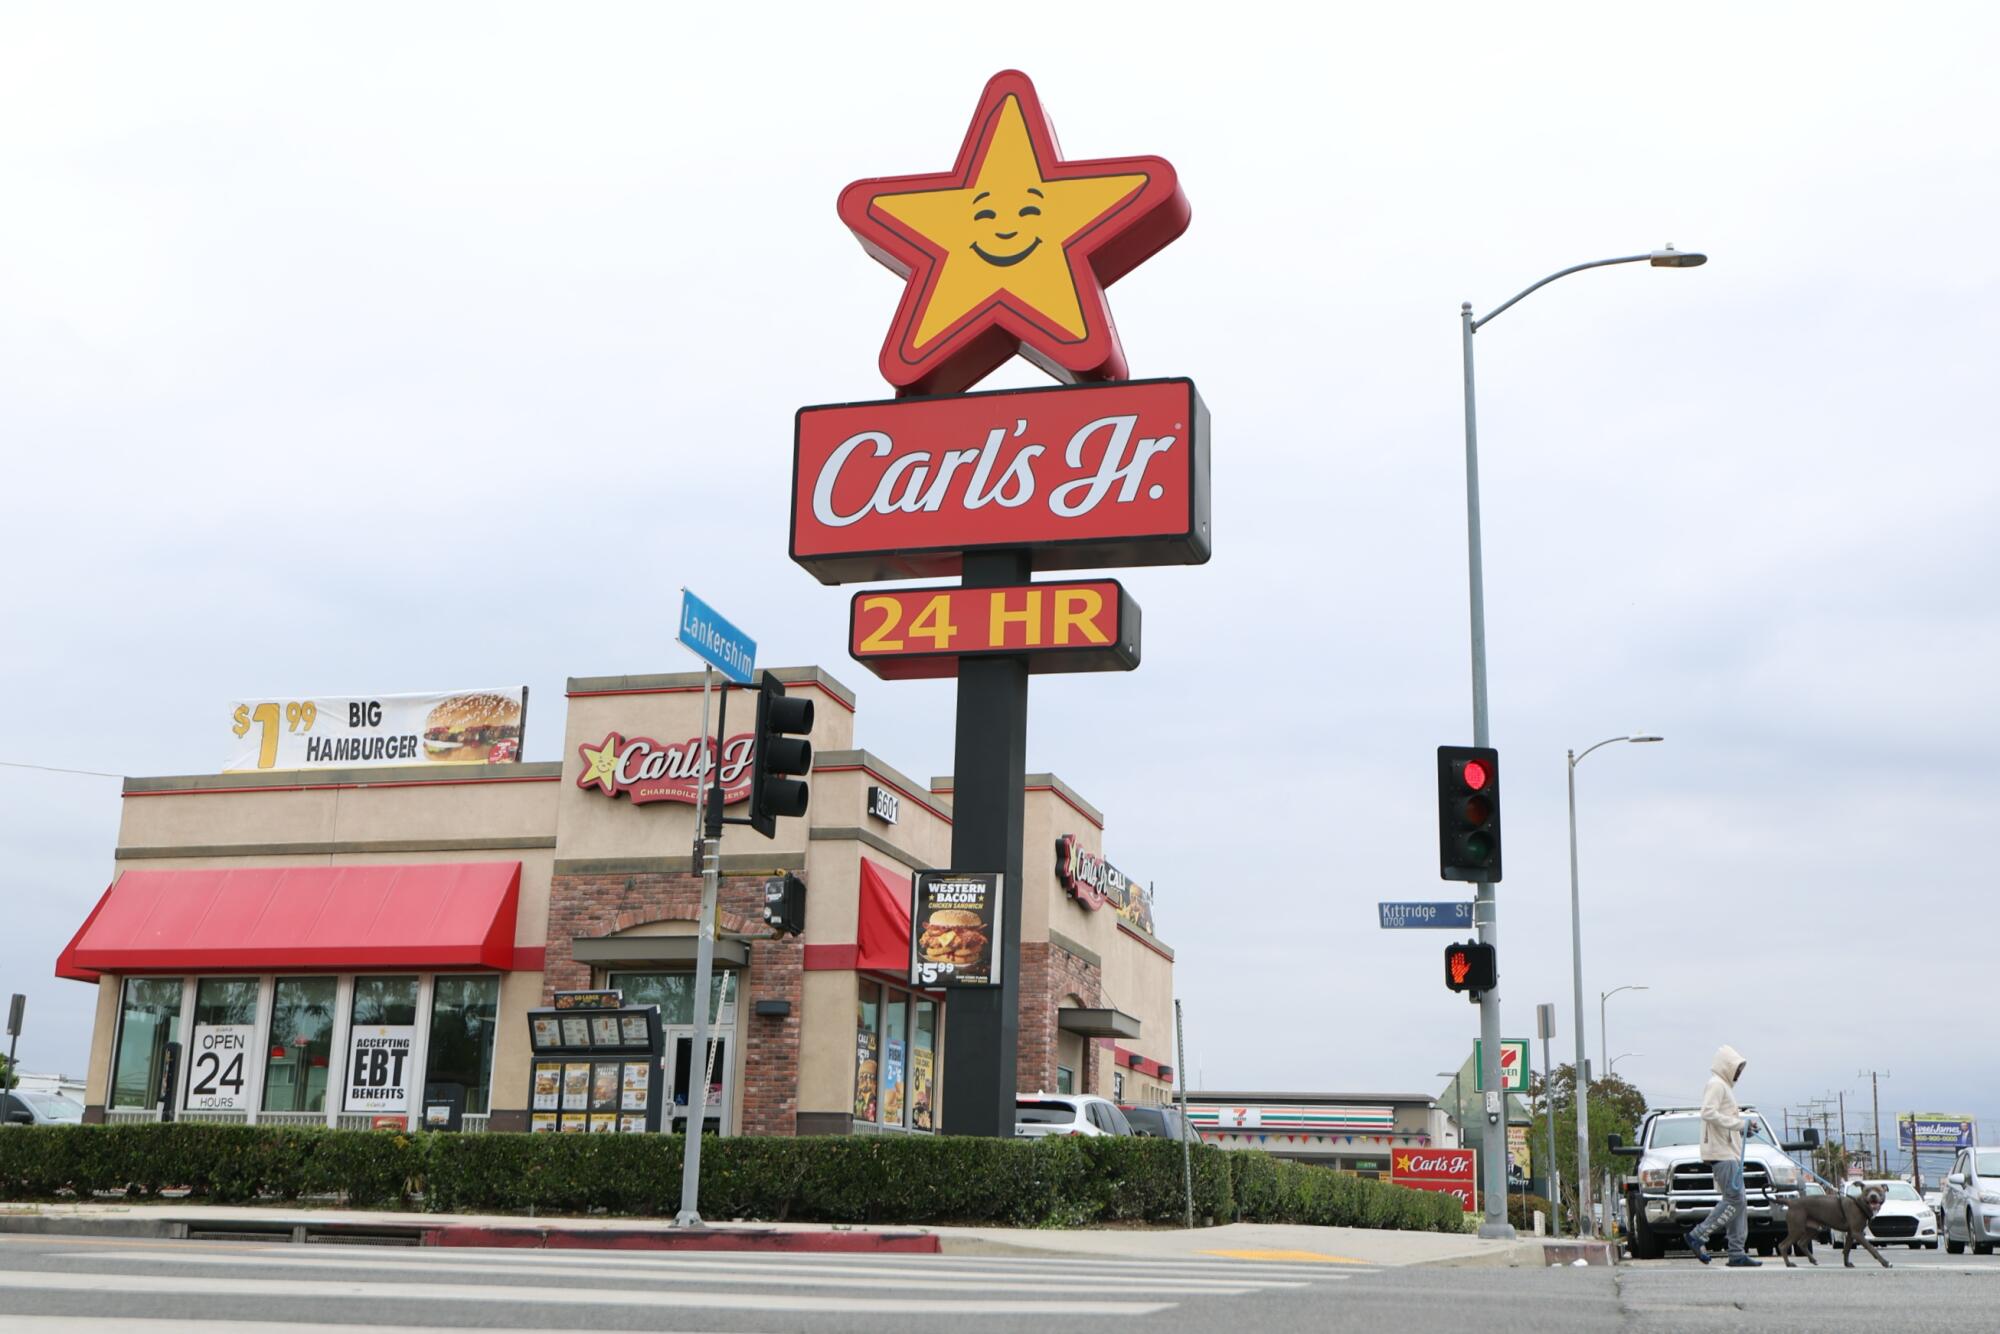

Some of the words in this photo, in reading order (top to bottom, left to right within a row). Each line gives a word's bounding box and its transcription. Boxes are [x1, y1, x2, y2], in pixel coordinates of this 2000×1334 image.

[811, 418, 1047, 527] Carl's
[1048, 414, 1177, 518] Jr.
[860, 594, 958, 651] 24
[988, 588, 1110, 647] HR
[683, 604, 752, 678] Lankershim
[349, 701, 382, 728] BIG
[306, 735, 418, 762] HAMBURGER
[640, 788, 699, 799] CHARBROILE
[877, 790, 898, 821] 6601
[928, 883, 986, 894] WESTERN
[936, 893, 976, 903] BACON
[1383, 904, 1436, 921] Kittridge
[1455, 904, 1469, 918] St
[1383, 917, 1405, 927] 11700
[203, 1034, 245, 1049] OPEN
[356, 1038, 410, 1048] ACCEPTING
[193, 1052, 244, 1095] 24
[353, 1048, 408, 1087] EBT
[200, 1097, 233, 1107] HOURS
[352, 1088, 404, 1099] BENEFITS
[1409, 1156, 1449, 1172] Carl's
[1449, 1156, 1469, 1173] Jr.
